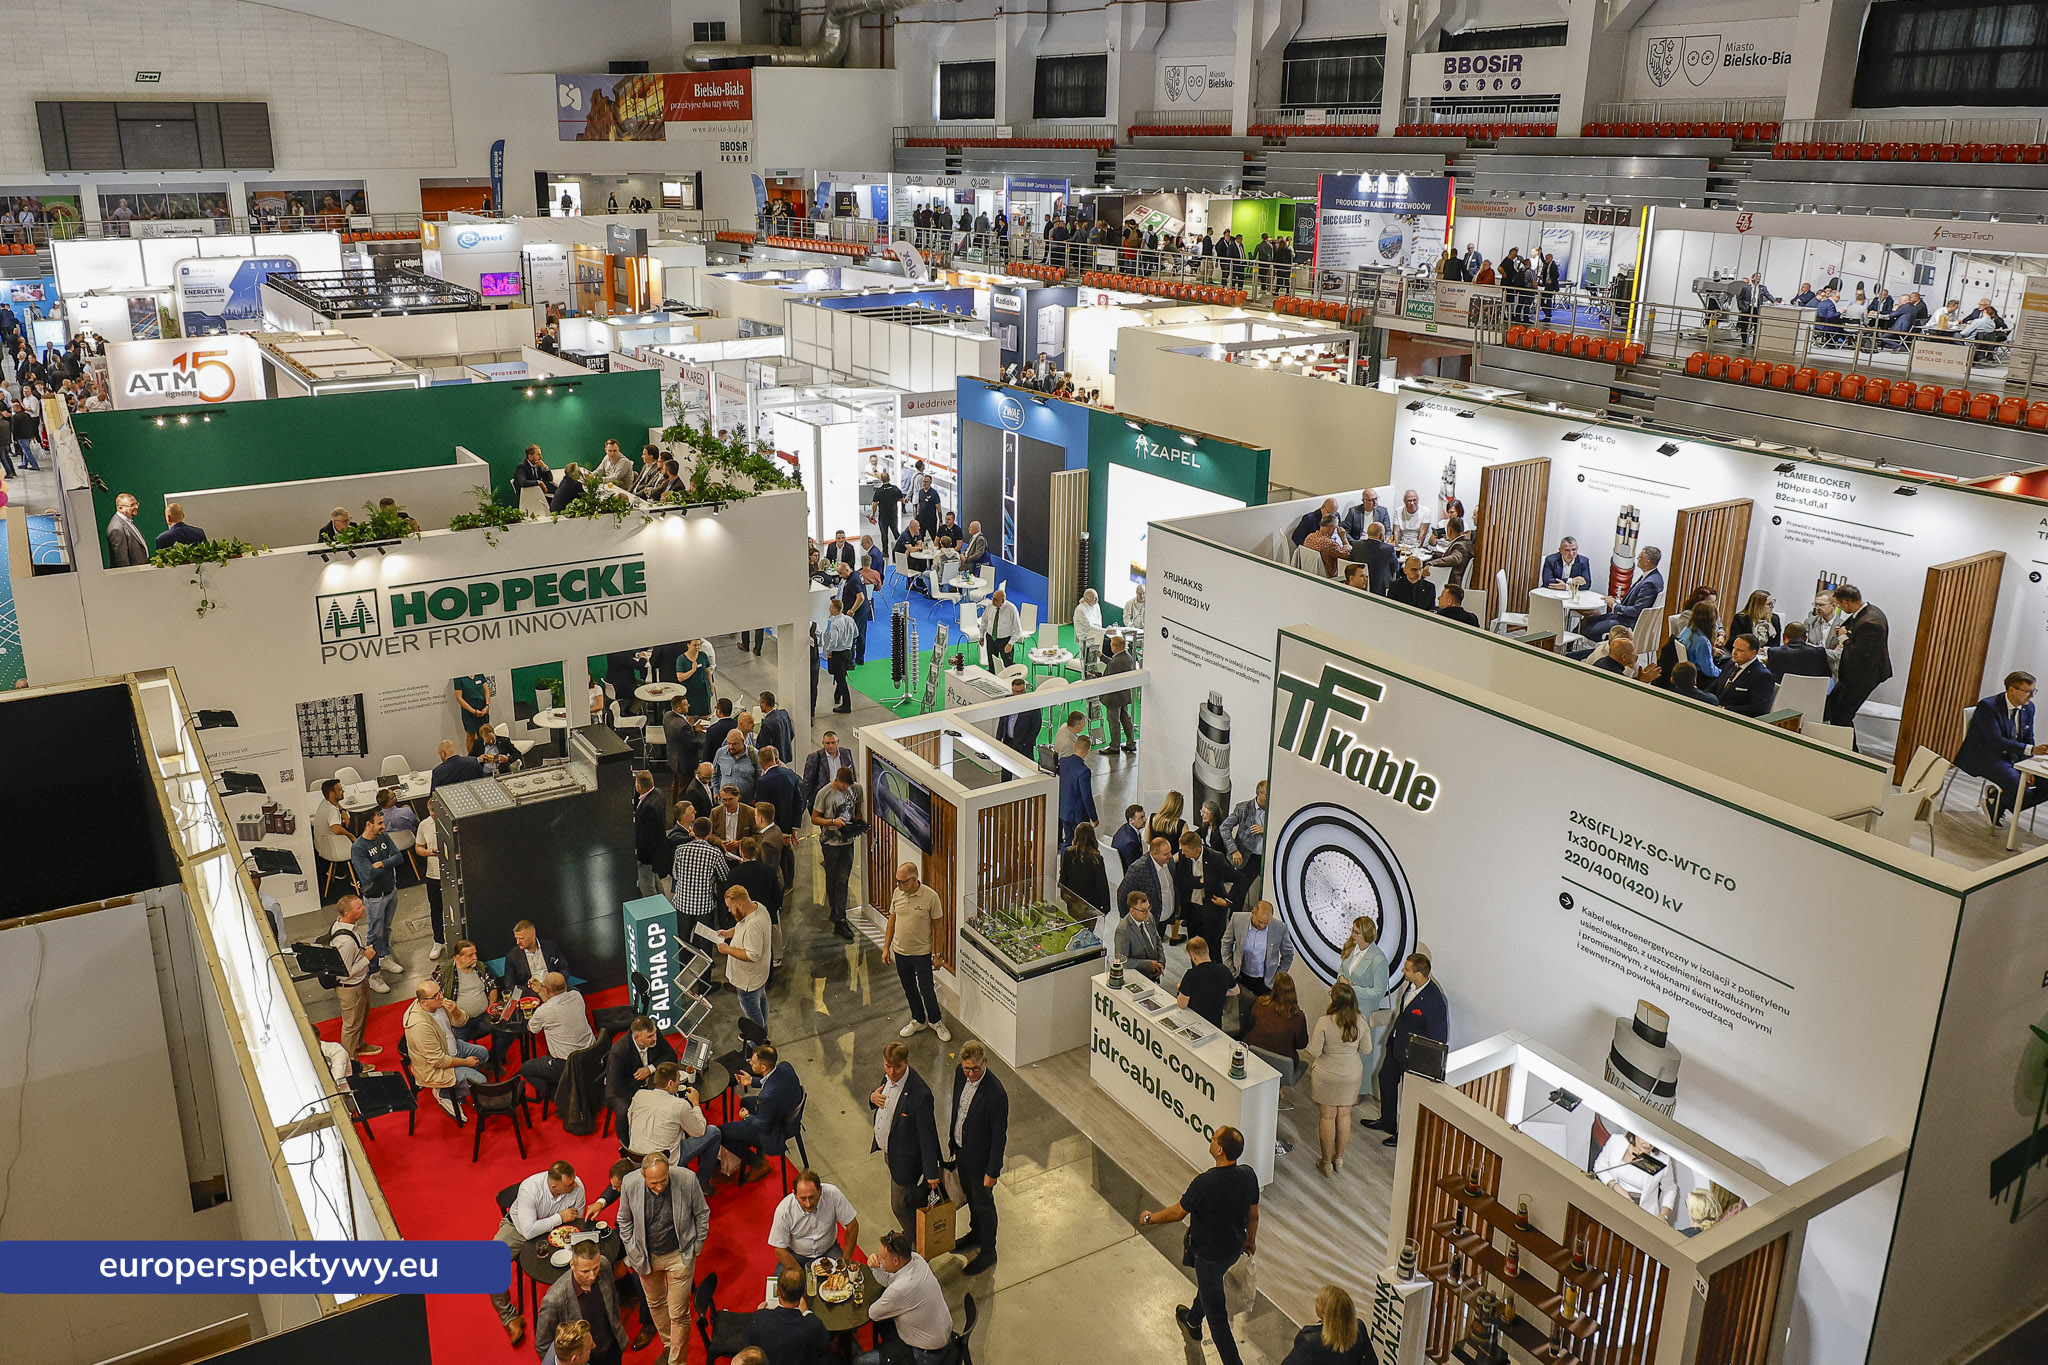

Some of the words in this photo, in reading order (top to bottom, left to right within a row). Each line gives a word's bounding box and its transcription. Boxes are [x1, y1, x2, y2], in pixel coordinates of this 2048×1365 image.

[1725, 42, 1755, 52] Miasto
[1444, 55, 1523, 74] BBOSiR
[1723, 52, 1792, 67] Bielsko-Bia
[694, 80, 745, 98] Bielsko-Biała
[1208, 78, 1235, 89] Bielsko-
[702, 101, 713, 109] dwa
[713, 100, 722, 110] razy
[722, 98, 740, 110] więcej
[720, 141, 748, 151] BBOSiR
[913, 176, 923, 184] LOPI
[944, 178, 957, 186] LOPI
[979, 178, 990, 186] LOPI
[1335, 199, 1369, 209] PRODUCENT
[1370, 200, 1388, 209] KABLI
[1392, 202, 1432, 211] PRZEWODÓW
[1461, 205, 1517, 214] TRANSFORMATORY
[1538, 204, 1575, 214] SGB-SMIT
[1323, 216, 1338, 225] BICC
[1339, 215, 1362, 225] CABLES
[184, 288, 225, 296] ENERGETYKI
[995, 297, 1018, 307] Radiolex
[1407, 301, 1434, 313] WYJŚCIE
[129, 370, 198, 393] ATM
[686, 369, 705, 386] KARED
[165, 389, 198, 399] lighting
[917, 399, 957, 410] leddriver.
[1002, 406, 1021, 420] ZWAE
[1606, 437, 1616, 445] Cu
[1150, 444, 1201, 469] ZAPEL
[1778, 472, 1851, 490] FLAMEBLOCKER
[1812, 488, 1848, 501] 450-750
[1849, 495, 1857, 503] V
[1885, 549, 1901, 558] pracy
[1163, 570, 1203, 592] XRUHAKXS
[390, 560, 647, 628] HOPPECKE
[1162, 586, 1200, 609] 64/110(123)
[1200, 601, 1211, 612] kV
[320, 632, 421, 665] POWER
[428, 619, 501, 649] FROM
[508, 599, 648, 637] INNOVATION
[1567, 830, 1650, 876] 1x3000RMS
[1569, 810, 1712, 881] 2XS(FL)2Y-SC-WTC
[1714, 872, 1737, 892] FO
[1564, 849, 1659, 904] 220/400(420)
[1662, 894, 1684, 913] kV
[647, 922, 668, 950] CP
[1580, 919, 1640, 956] usieciowanego,
[1646, 953, 1712, 991] uszczelnieniem
[1712, 984, 1765, 1017] wzdłużnym
[1581, 906, 1605, 924] Kabel
[1605, 919, 1690, 967] elektroenergetyczny
[1699, 964, 1731, 988] izolacji
[1737, 985, 1791, 1017] polietylenu
[649, 949, 670, 1011] ALPHA
[1580, 944, 1625, 974] zewnętrzną
[1625, 967, 1662, 993] powłoką
[1662, 984, 1734, 1031] półprzewodzącą
[1582, 932, 1643, 969] promieniowym,
[1649, 965, 1691, 993] włóknami
[1691, 986, 1773, 1035] światłowodowymi
[1094, 991, 1216, 1103] tfkable.com
[1091, 1026, 1214, 1144] jdrcables.co
[1696, 1279, 1706, 1294] 19
